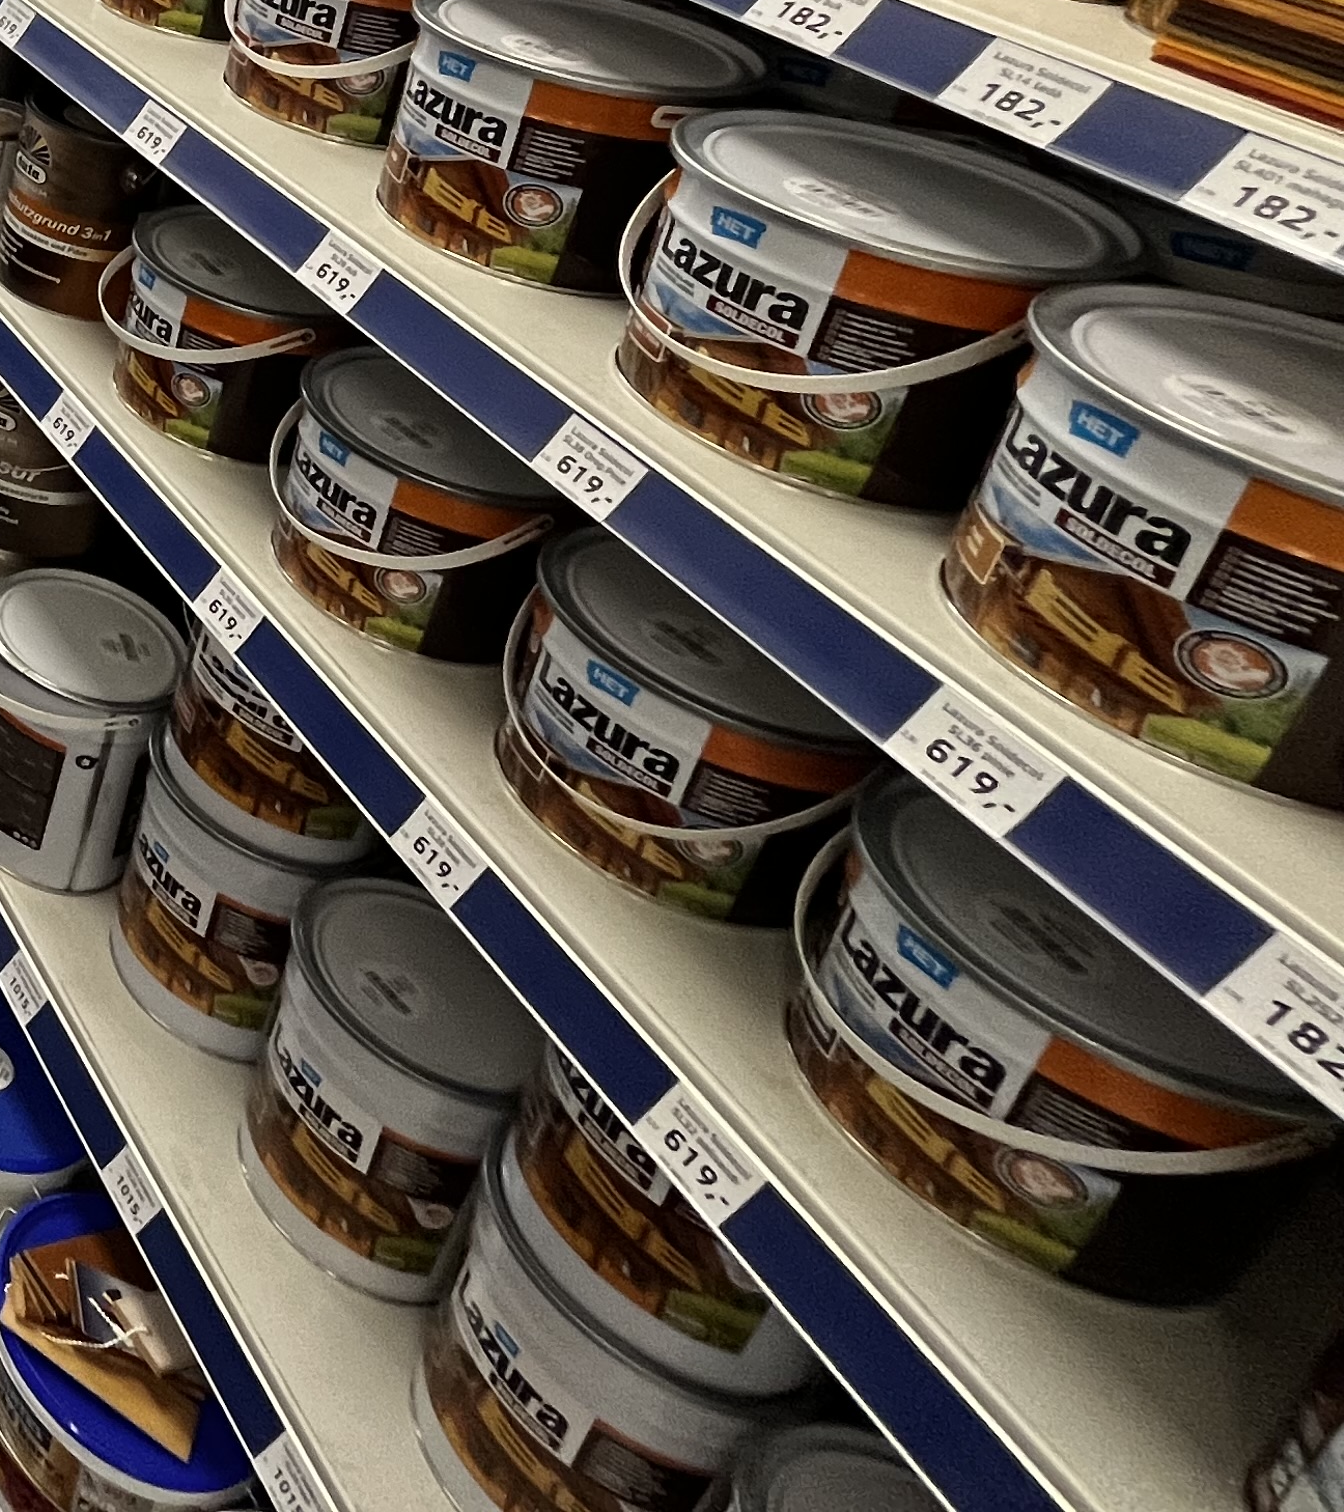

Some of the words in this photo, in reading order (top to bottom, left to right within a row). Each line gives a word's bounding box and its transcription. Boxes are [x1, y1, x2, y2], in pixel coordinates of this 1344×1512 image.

[777, 0, 843, 39] 182,-
[978, 82, 1061, 129] 182,-
[136, 126, 166, 155] 619,-
[715, 211, 757, 241] HET
[1233, 186, 1340, 239] 182,-
[315, 263, 356, 300] 619,-
[661, 222, 809, 331] Lazura
[712, 301, 787, 344] SOLDECOL
[52, 417, 78, 449] 619,-
[1077, 408, 1124, 448] HET
[557, 455, 612, 503] 619,-
[1007, 404, 1192, 568] Lazura
[208, 599, 243, 640] 619,-
[926, 738, 1015, 813] 619,-
[412, 835, 459, 893] 619,-
[663, 1128, 731, 1207] 619,-
[115, 1174, 144, 1227] 1015,-
